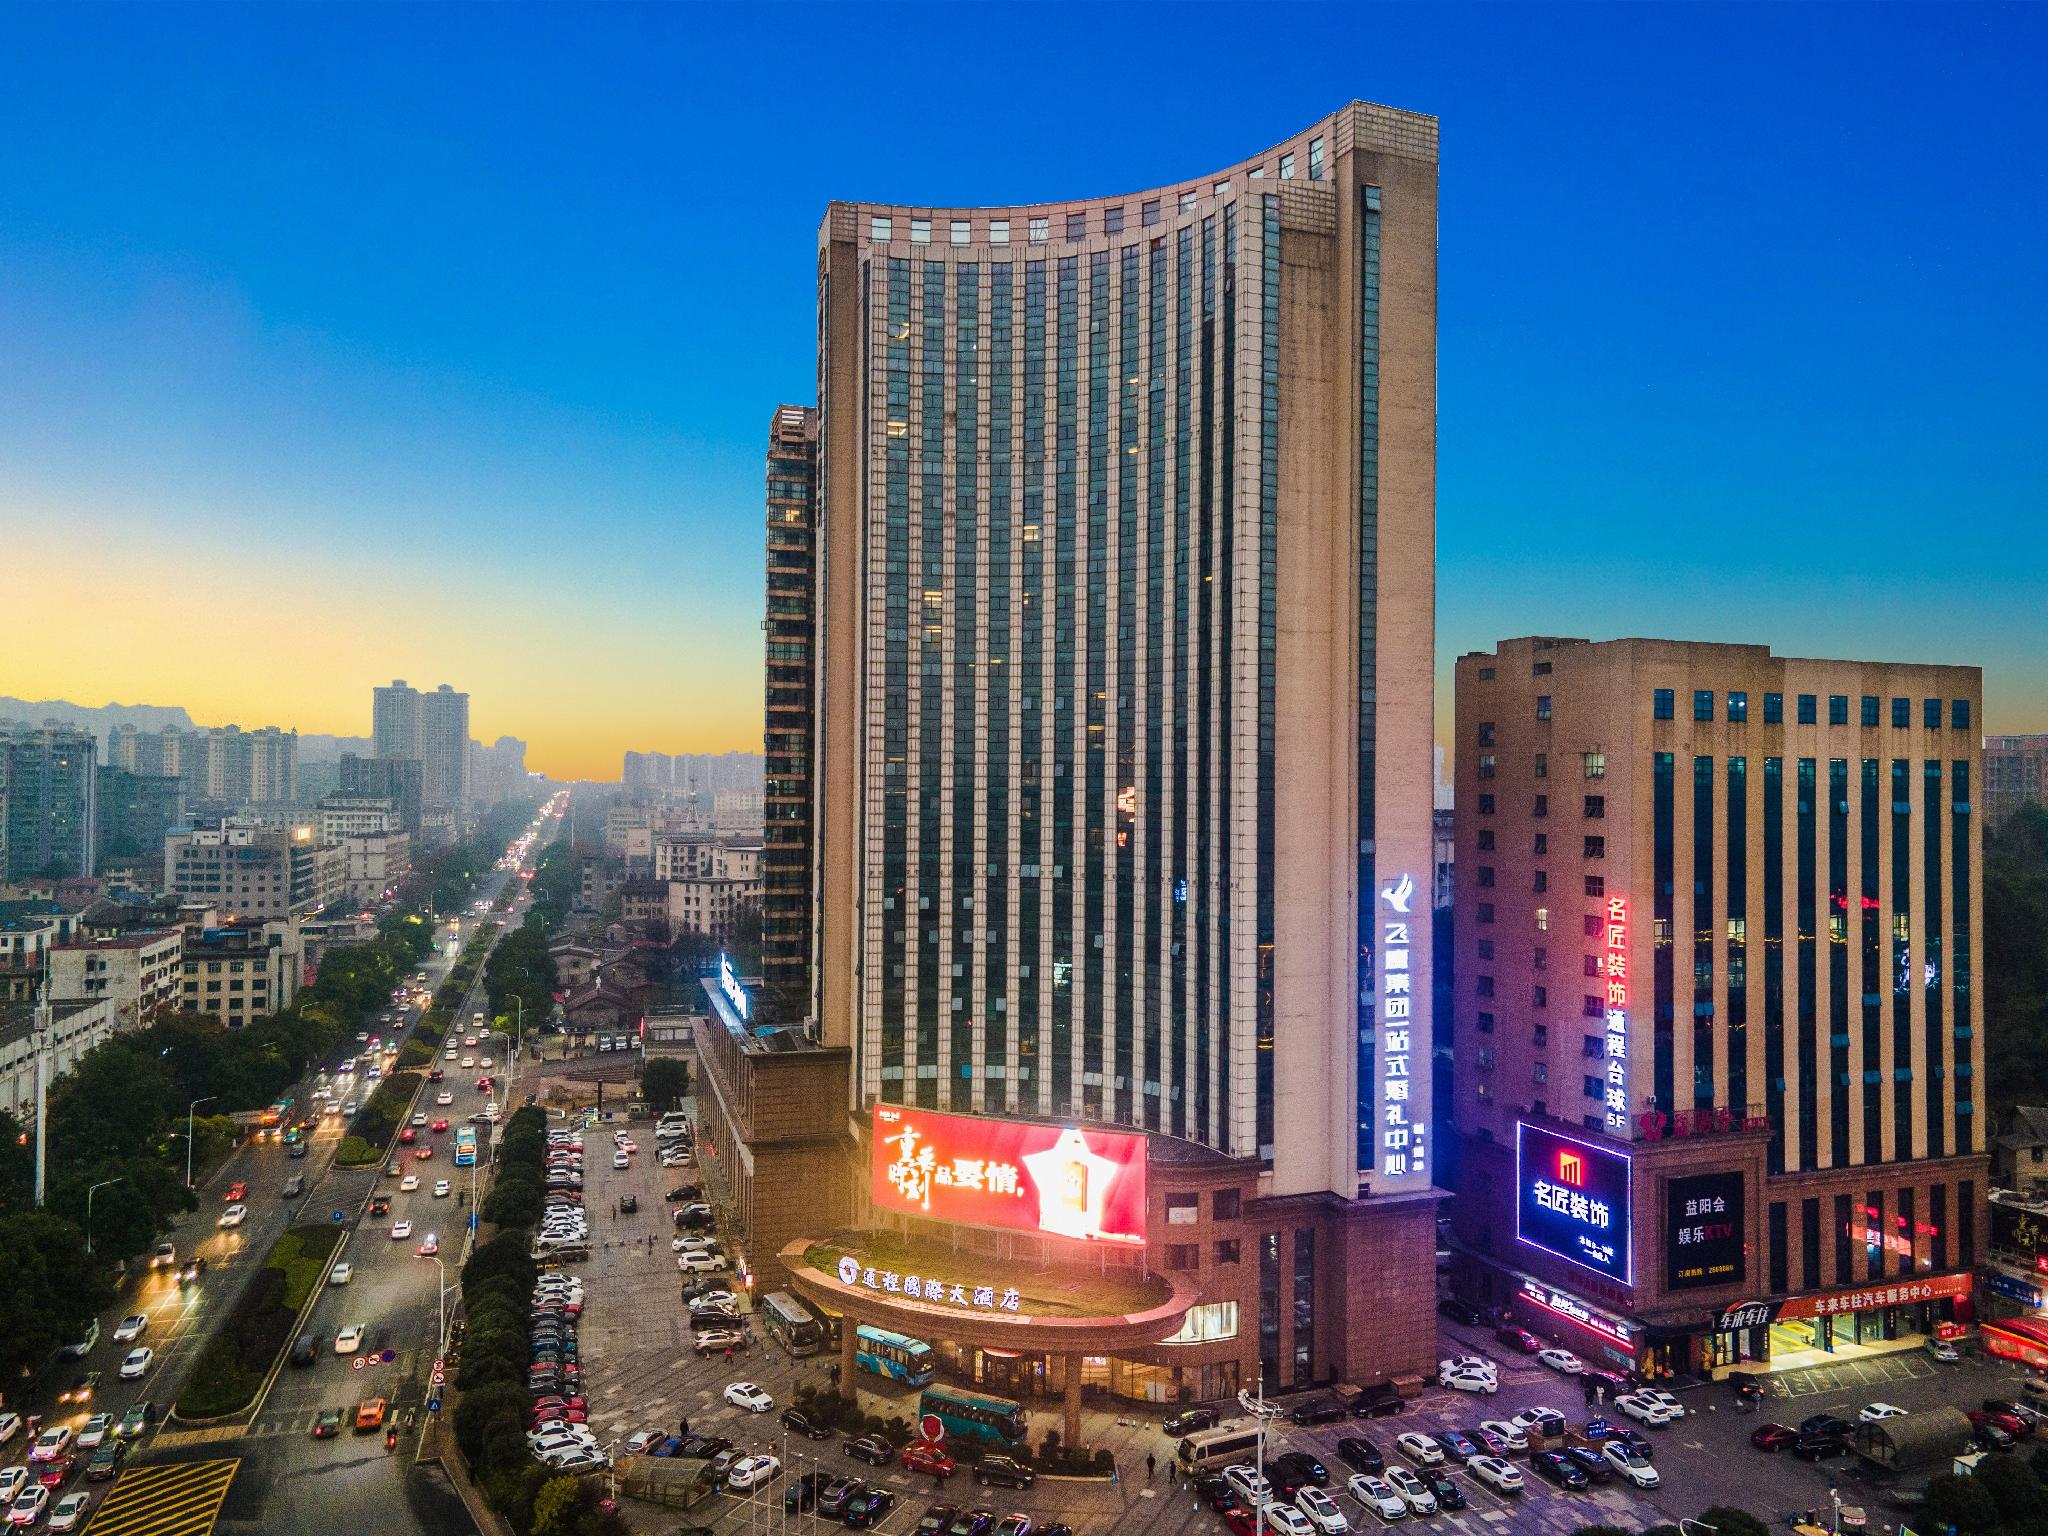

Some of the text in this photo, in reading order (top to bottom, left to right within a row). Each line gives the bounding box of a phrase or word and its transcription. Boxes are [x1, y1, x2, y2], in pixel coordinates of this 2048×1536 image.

[1607, 896, 1626, 1006] 名匠装饰
[1533, 1179, 1609, 1229] 名匠装饰
[1685, 1196, 1725, 1217] 益阳会
[862, 1267, 1020, 1311] 通程國際大酒店
[1815, 1284, 1931, 1313] 车来车往汽车服务中心
[1719, 1306, 1769, 1329] 车来车往
